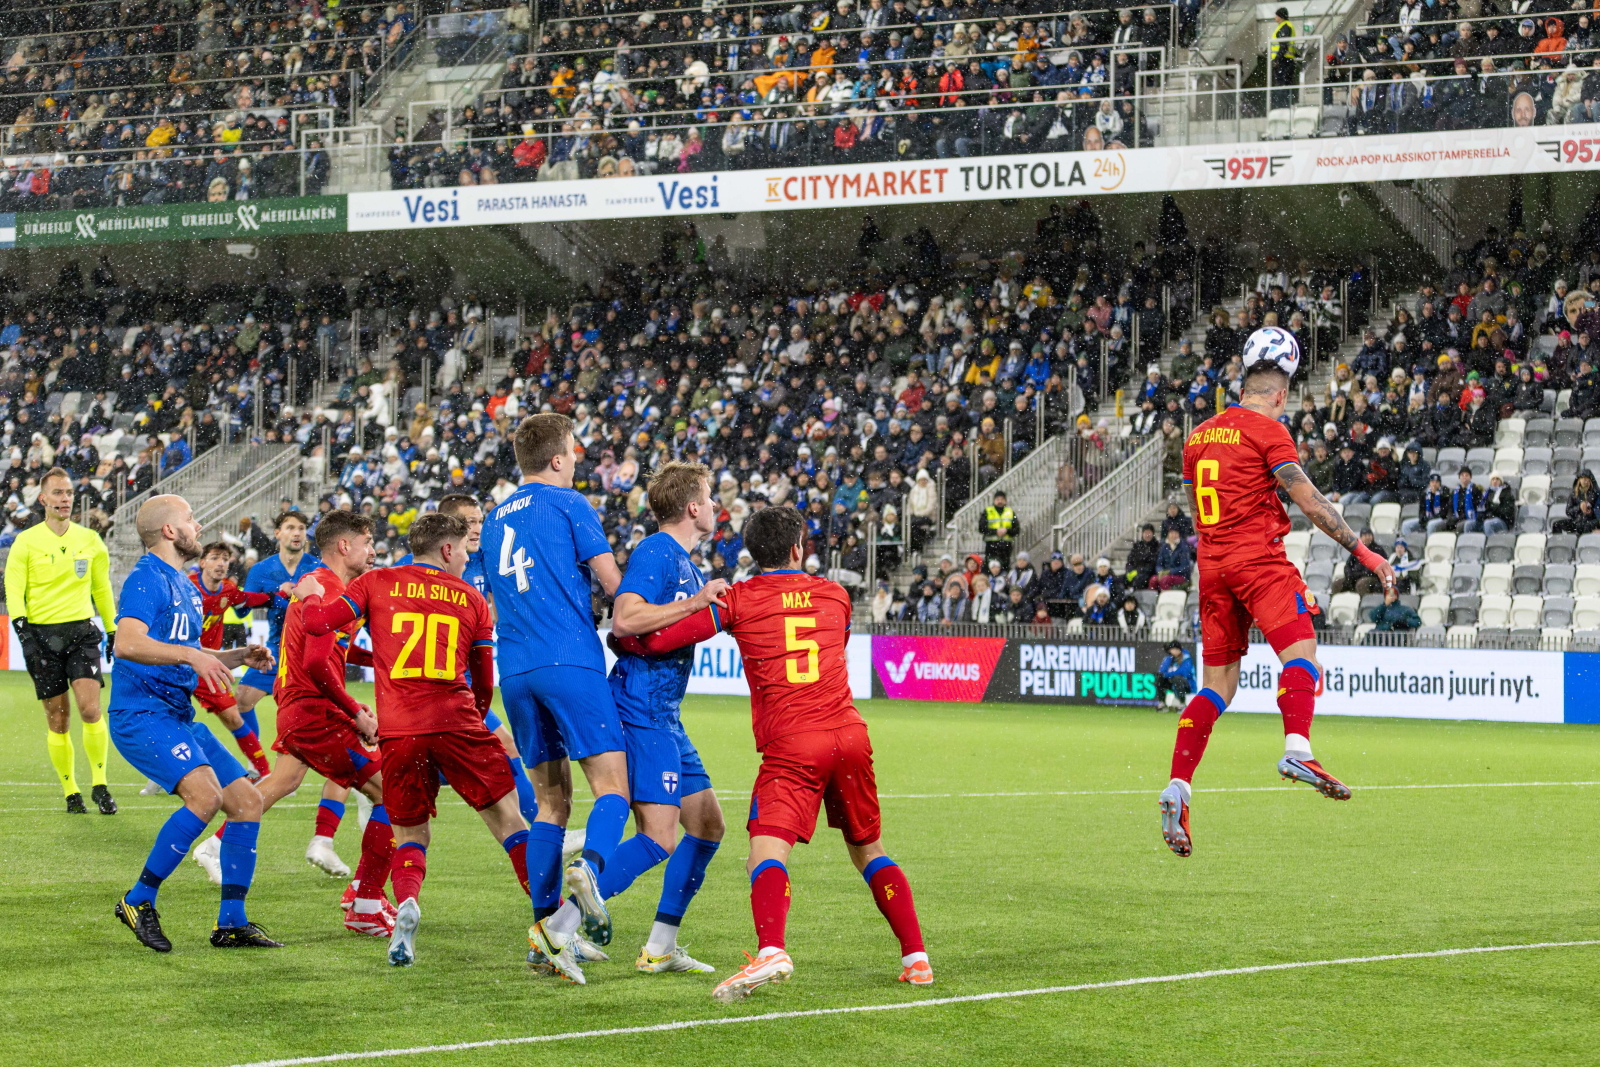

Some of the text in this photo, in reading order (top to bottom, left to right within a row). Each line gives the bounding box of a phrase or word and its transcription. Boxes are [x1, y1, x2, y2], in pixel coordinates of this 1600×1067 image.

[1093, 157, 1120, 178] 24h
[1227, 155, 1268, 180] 957
[1316, 147, 1511, 167] ROCK JA POP KLASSIKOT TAMPEREELLA
[960, 160, 1087, 192] TURTOLA
[477, 193, 588, 212] PARASTA HANASTA
[658, 174, 720, 210] Vesi
[181, 206, 337, 227] URHEILU MEHILÄINEN
[403, 189, 460, 223] Vesi
[24, 215, 170, 235] URHEILU MEHILÄINEN
[1203, 427, 1241, 446] GARCIA
[1195, 459, 1220, 525] 6
[494, 494, 534, 521] IVANOV
[498, 522, 535, 594] 4
[425, 568, 440, 576] FAF
[389, 581, 468, 608] J. DA SILVA
[781, 591, 813, 609] MAX
[169, 612, 190, 640] 10
[389, 611, 460, 681] 20
[783, 616, 820, 684] 5
[1019, 643, 1136, 673] PAREMMAN
[691, 647, 745, 679] ALI
[913, 661, 981, 682] VEIKKAUS
[1019, 670, 1158, 700] PELIN PUOLES
[1238, 664, 1272, 690] edä
[1349, 666, 1444, 698] puhutaan
[1447, 669, 1495, 702] juuri
[1500, 675, 1540, 704] nyt.
